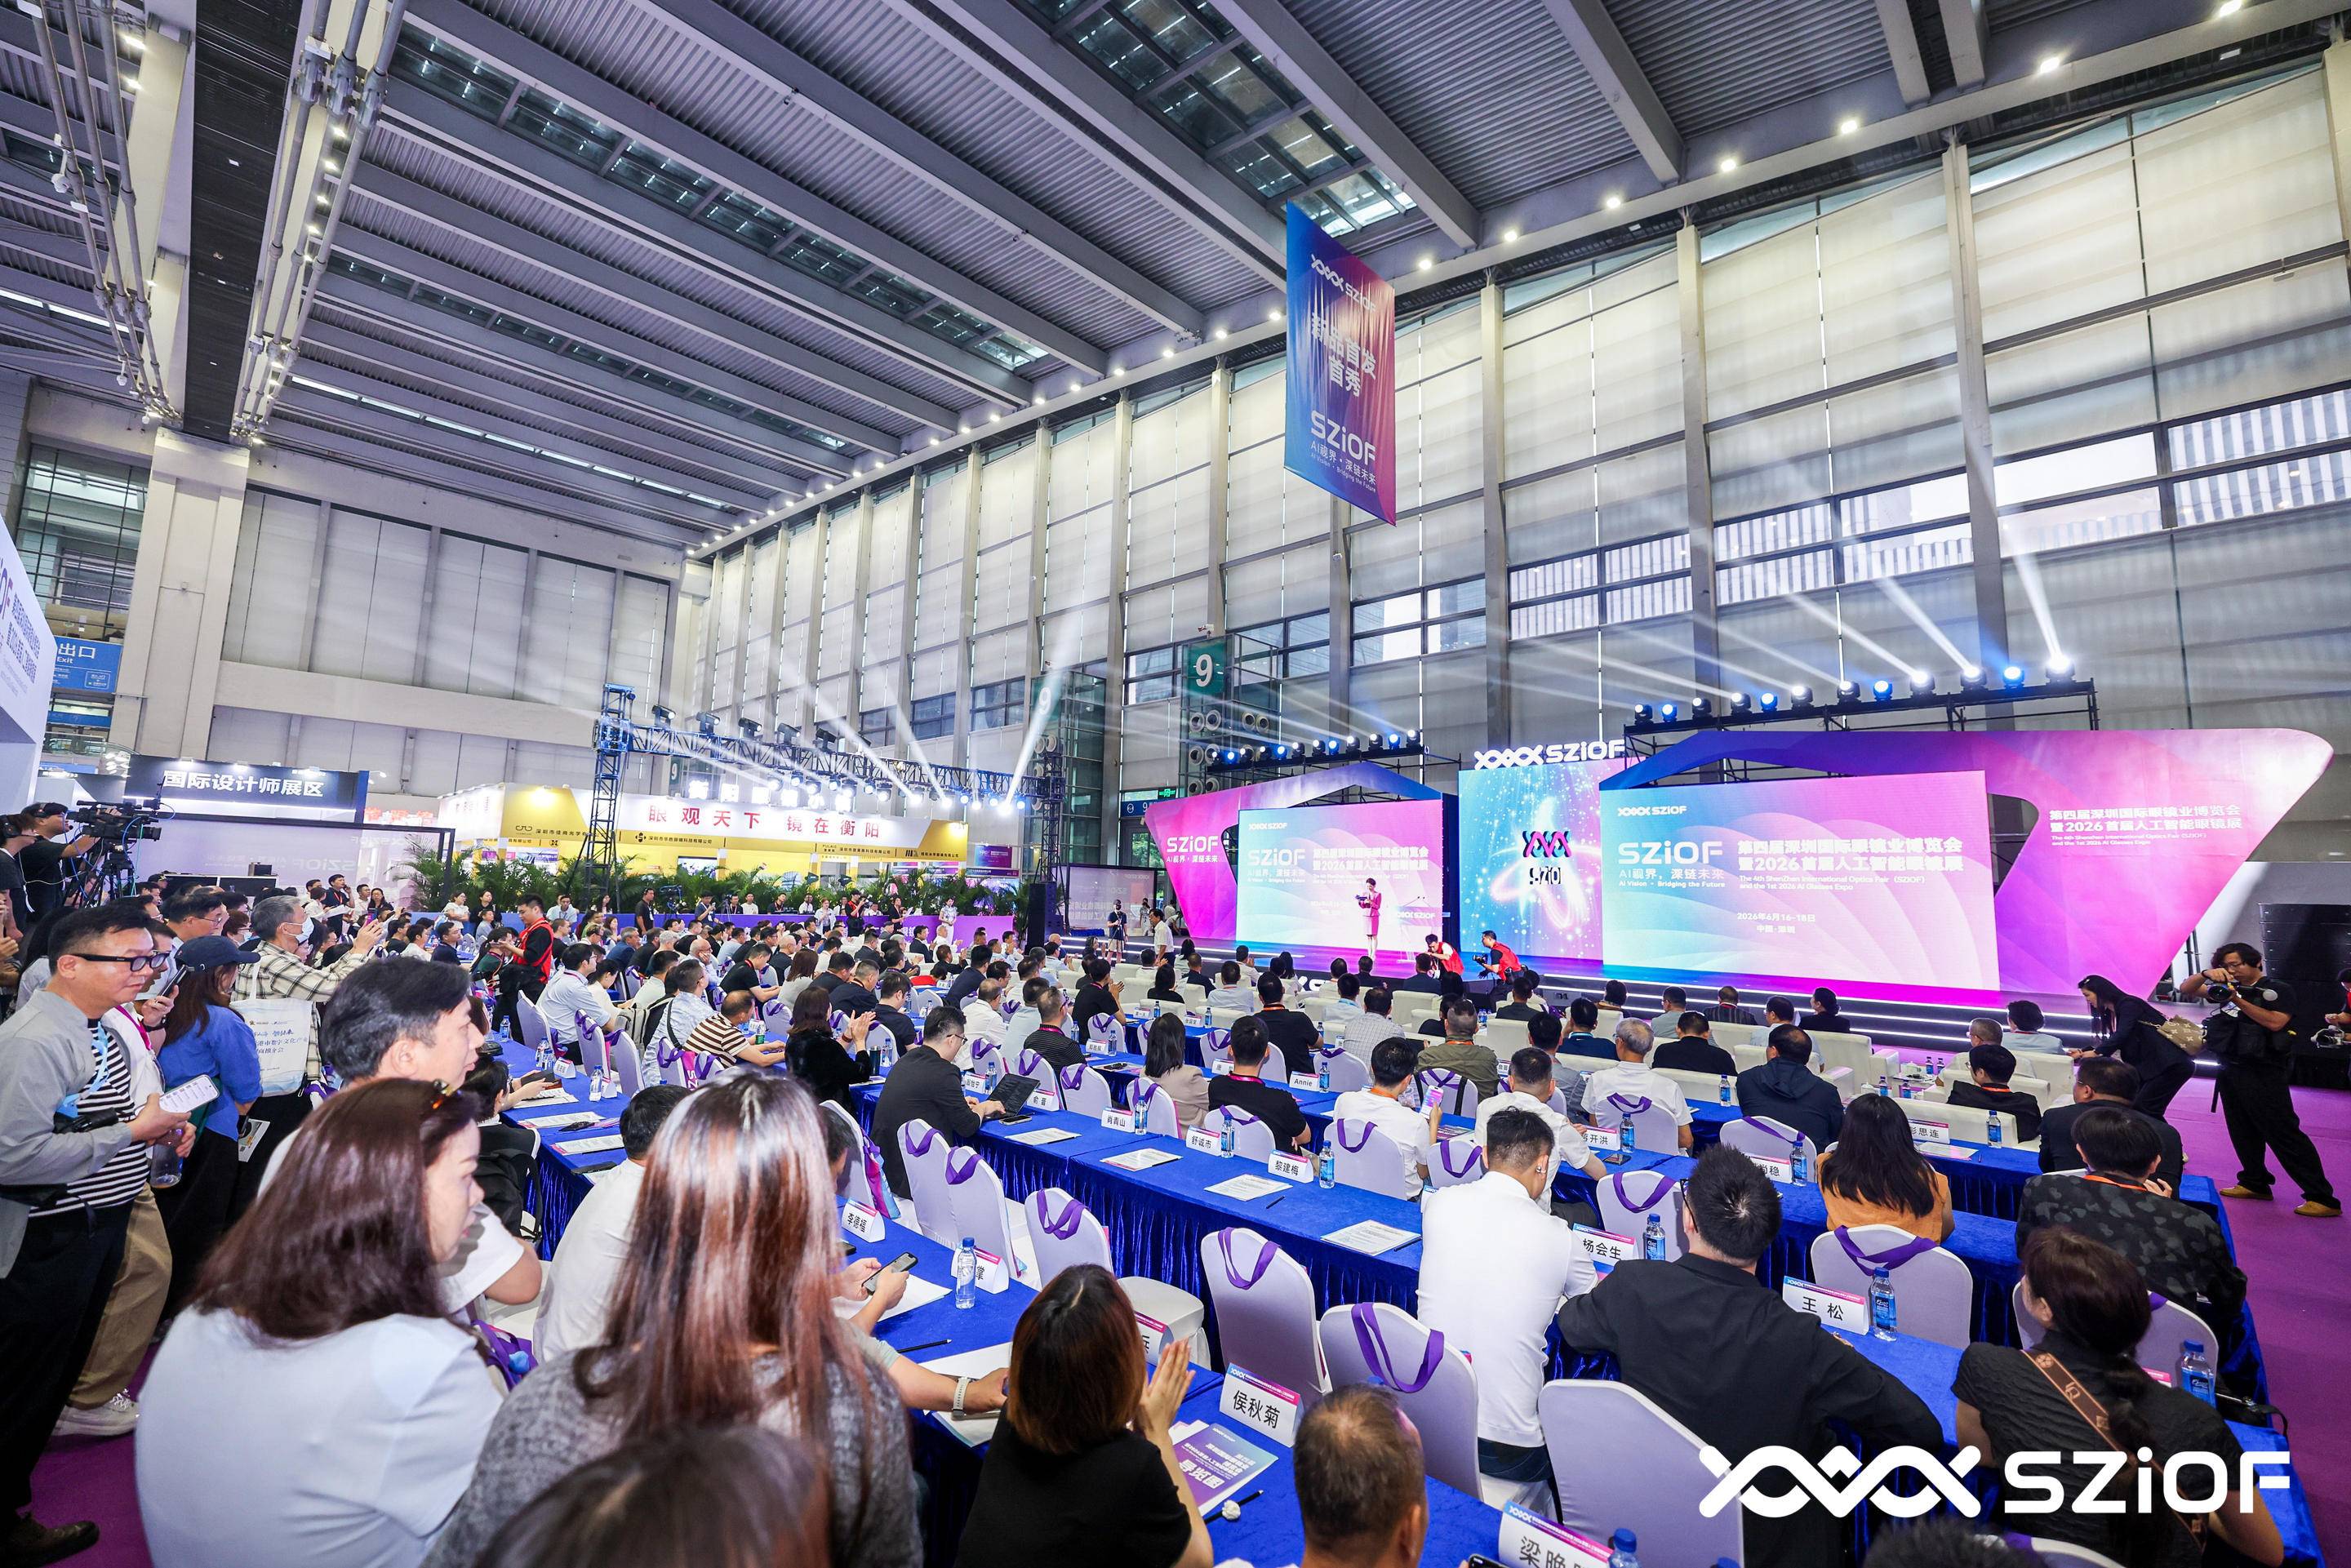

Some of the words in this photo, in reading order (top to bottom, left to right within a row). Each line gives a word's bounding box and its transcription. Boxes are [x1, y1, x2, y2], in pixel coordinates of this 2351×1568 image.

[1311, 312, 1376, 380] 新品首发
[1329, 355, 1361, 398] 首秀
[1310, 410, 1377, 466] SZiOF
[57, 656, 73, 664] Exit
[58, 642, 96, 660] 出口
[1195, 653, 1214, 687] 9
[1545, 740, 1625, 764] SZiOF
[163, 770, 324, 797] 国际设计师展区
[648, 805, 761, 829] 眼观天下
[786, 815, 879, 839] 镜在衡阳
[2049, 805, 2241, 821] 第四届深圳国际眼镜业博览会
[1167, 835, 1219, 853] SZiOF
[1618, 840, 1723, 865] SZiOF
[1658, 881, 1687, 889] Bridging
[1294, 1078, 1313, 1087] Annie
[1107, 1115, 1126, 1128] 肖青山
[1274, 1160, 1300, 1176] 黎建梅
[1582, 1237, 1622, 1259] 杨会生
[1233, 1389, 1281, 1429] 侯秋菊
[1179, 1459, 1225, 1490] 导览图
